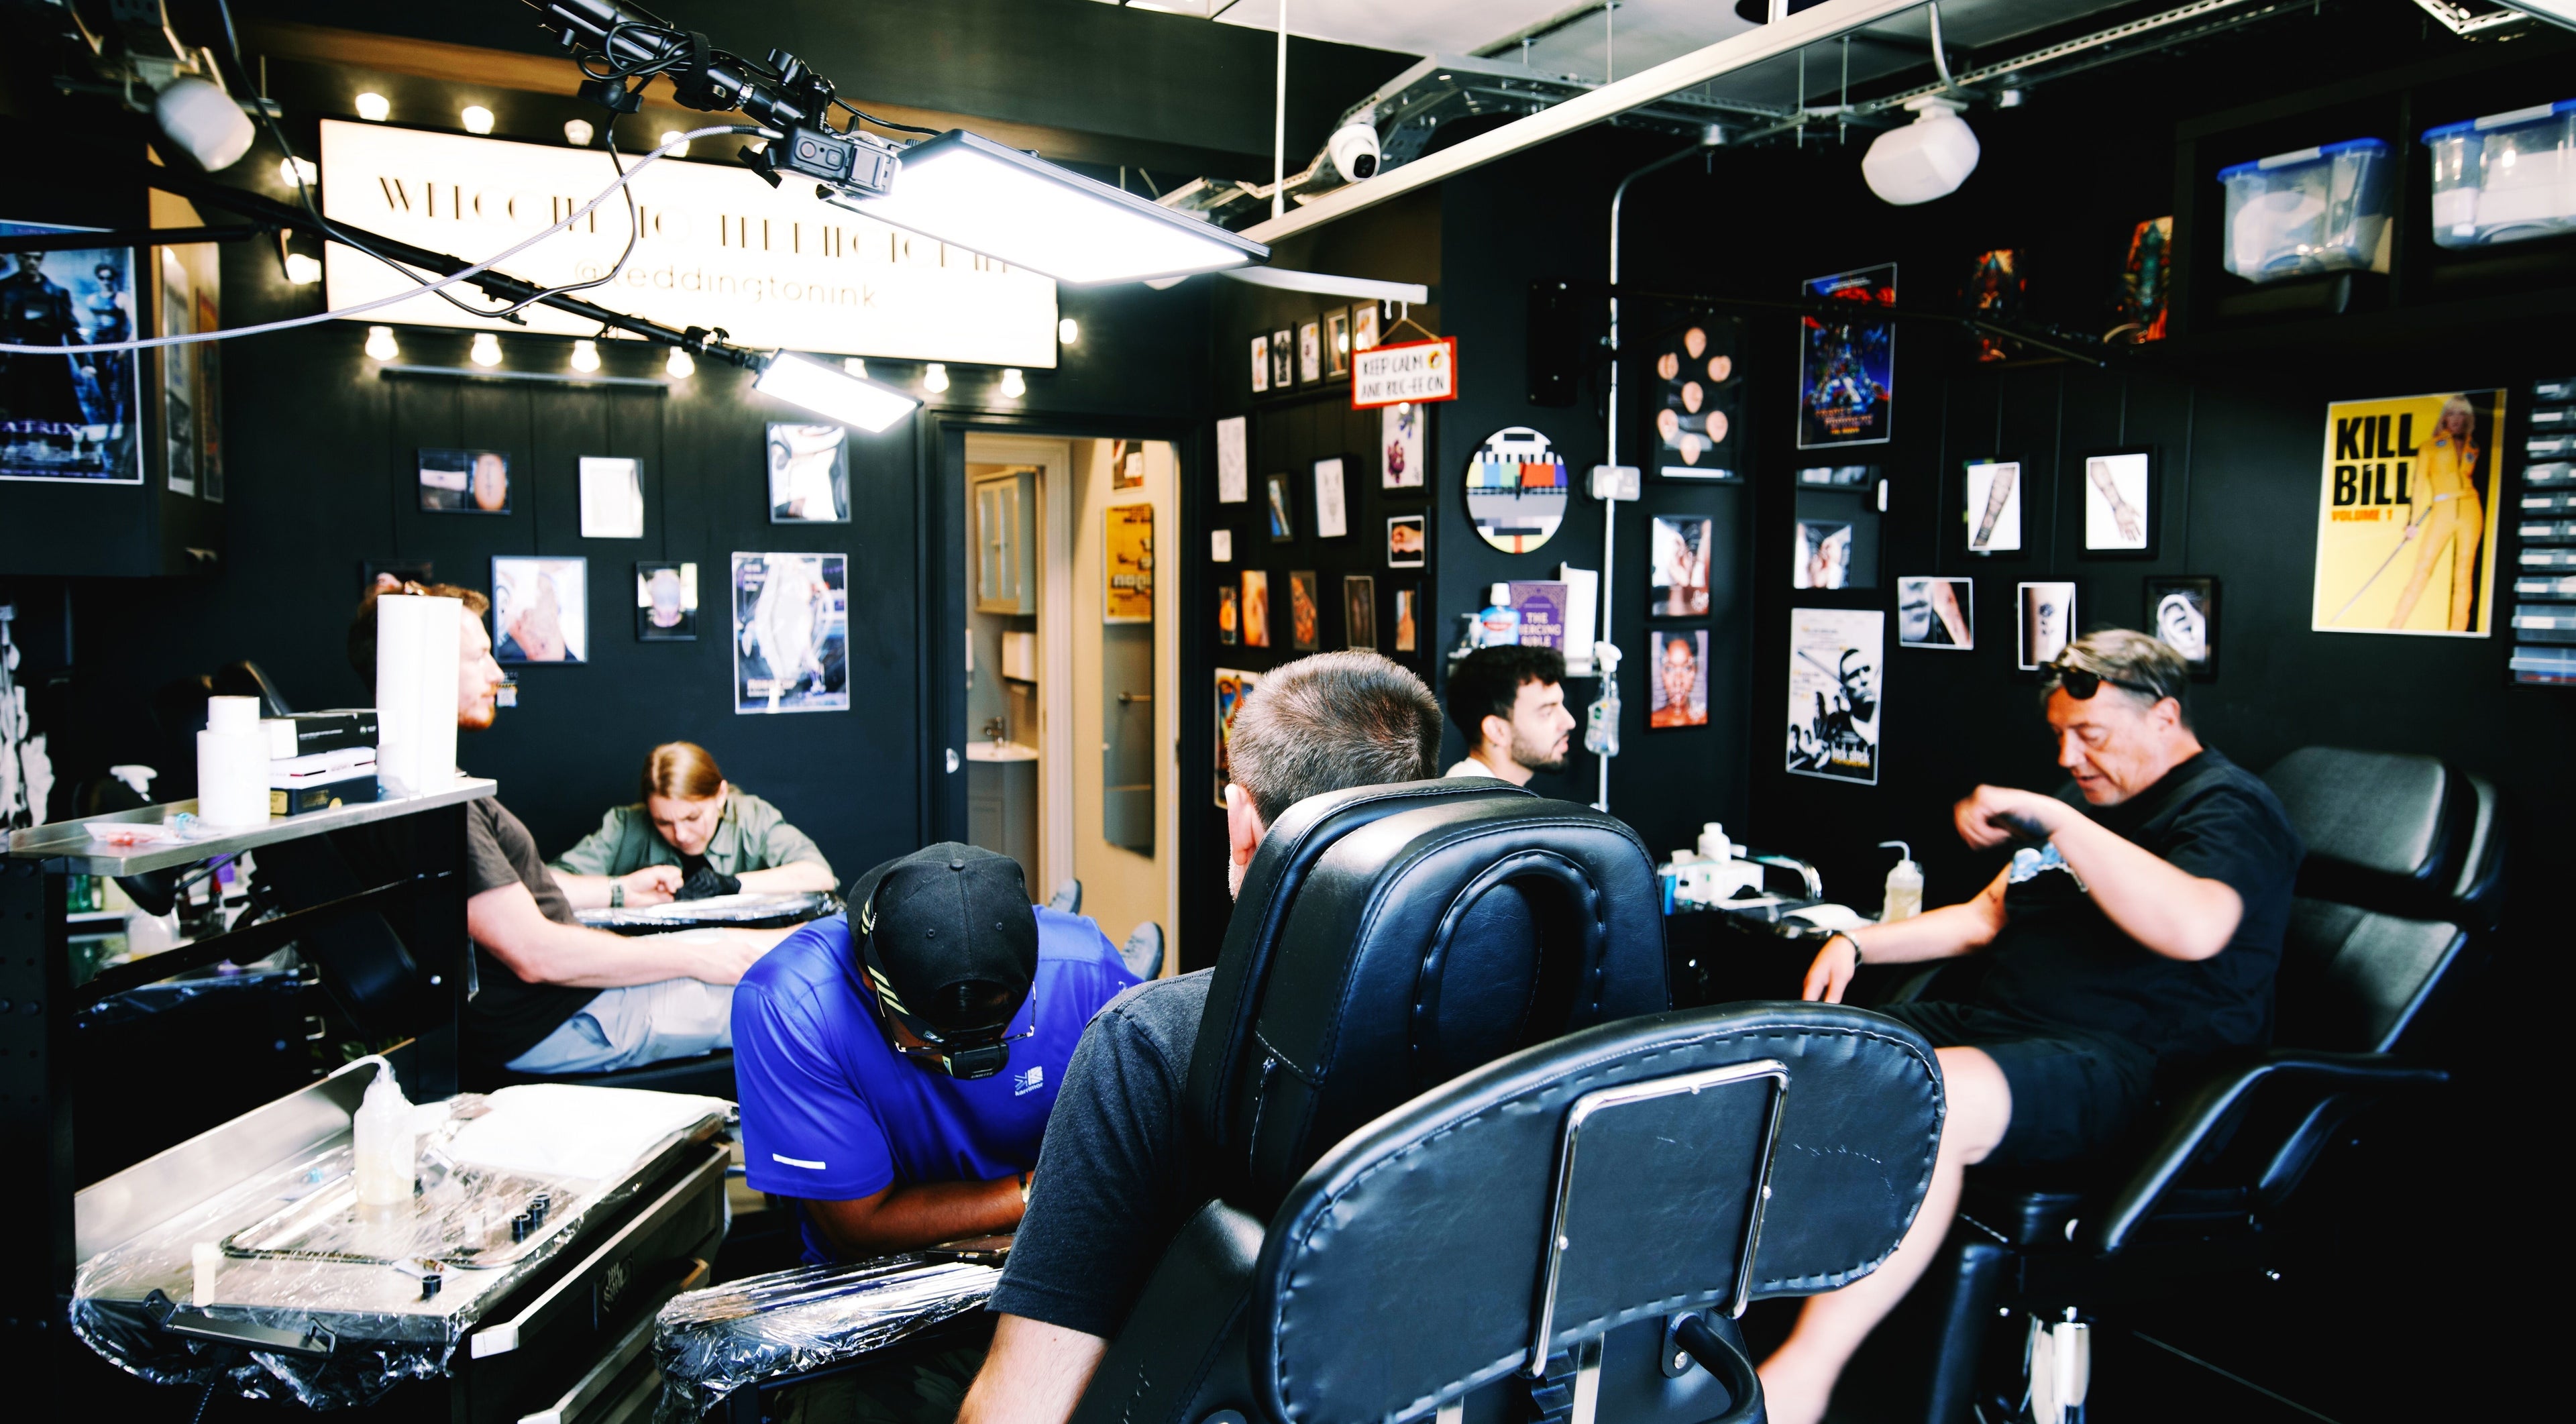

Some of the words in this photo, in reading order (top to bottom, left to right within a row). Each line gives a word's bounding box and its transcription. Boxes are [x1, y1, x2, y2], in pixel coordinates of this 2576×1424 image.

[574, 258, 878, 308] @teddingtonink
[1364, 355, 1389, 376] KEEP
[1392, 353, 1423, 373] CALM
[0, 420, 81, 435] ATRIX
[2336, 413, 2419, 460] KILL
[2333, 461, 2412, 506] BILL
[2331, 508, 2380, 521] VOLUME
[2387, 508, 2393, 521] 1
[1525, 612, 1548, 624] THE
[1518, 624, 1562, 636] IERCING
